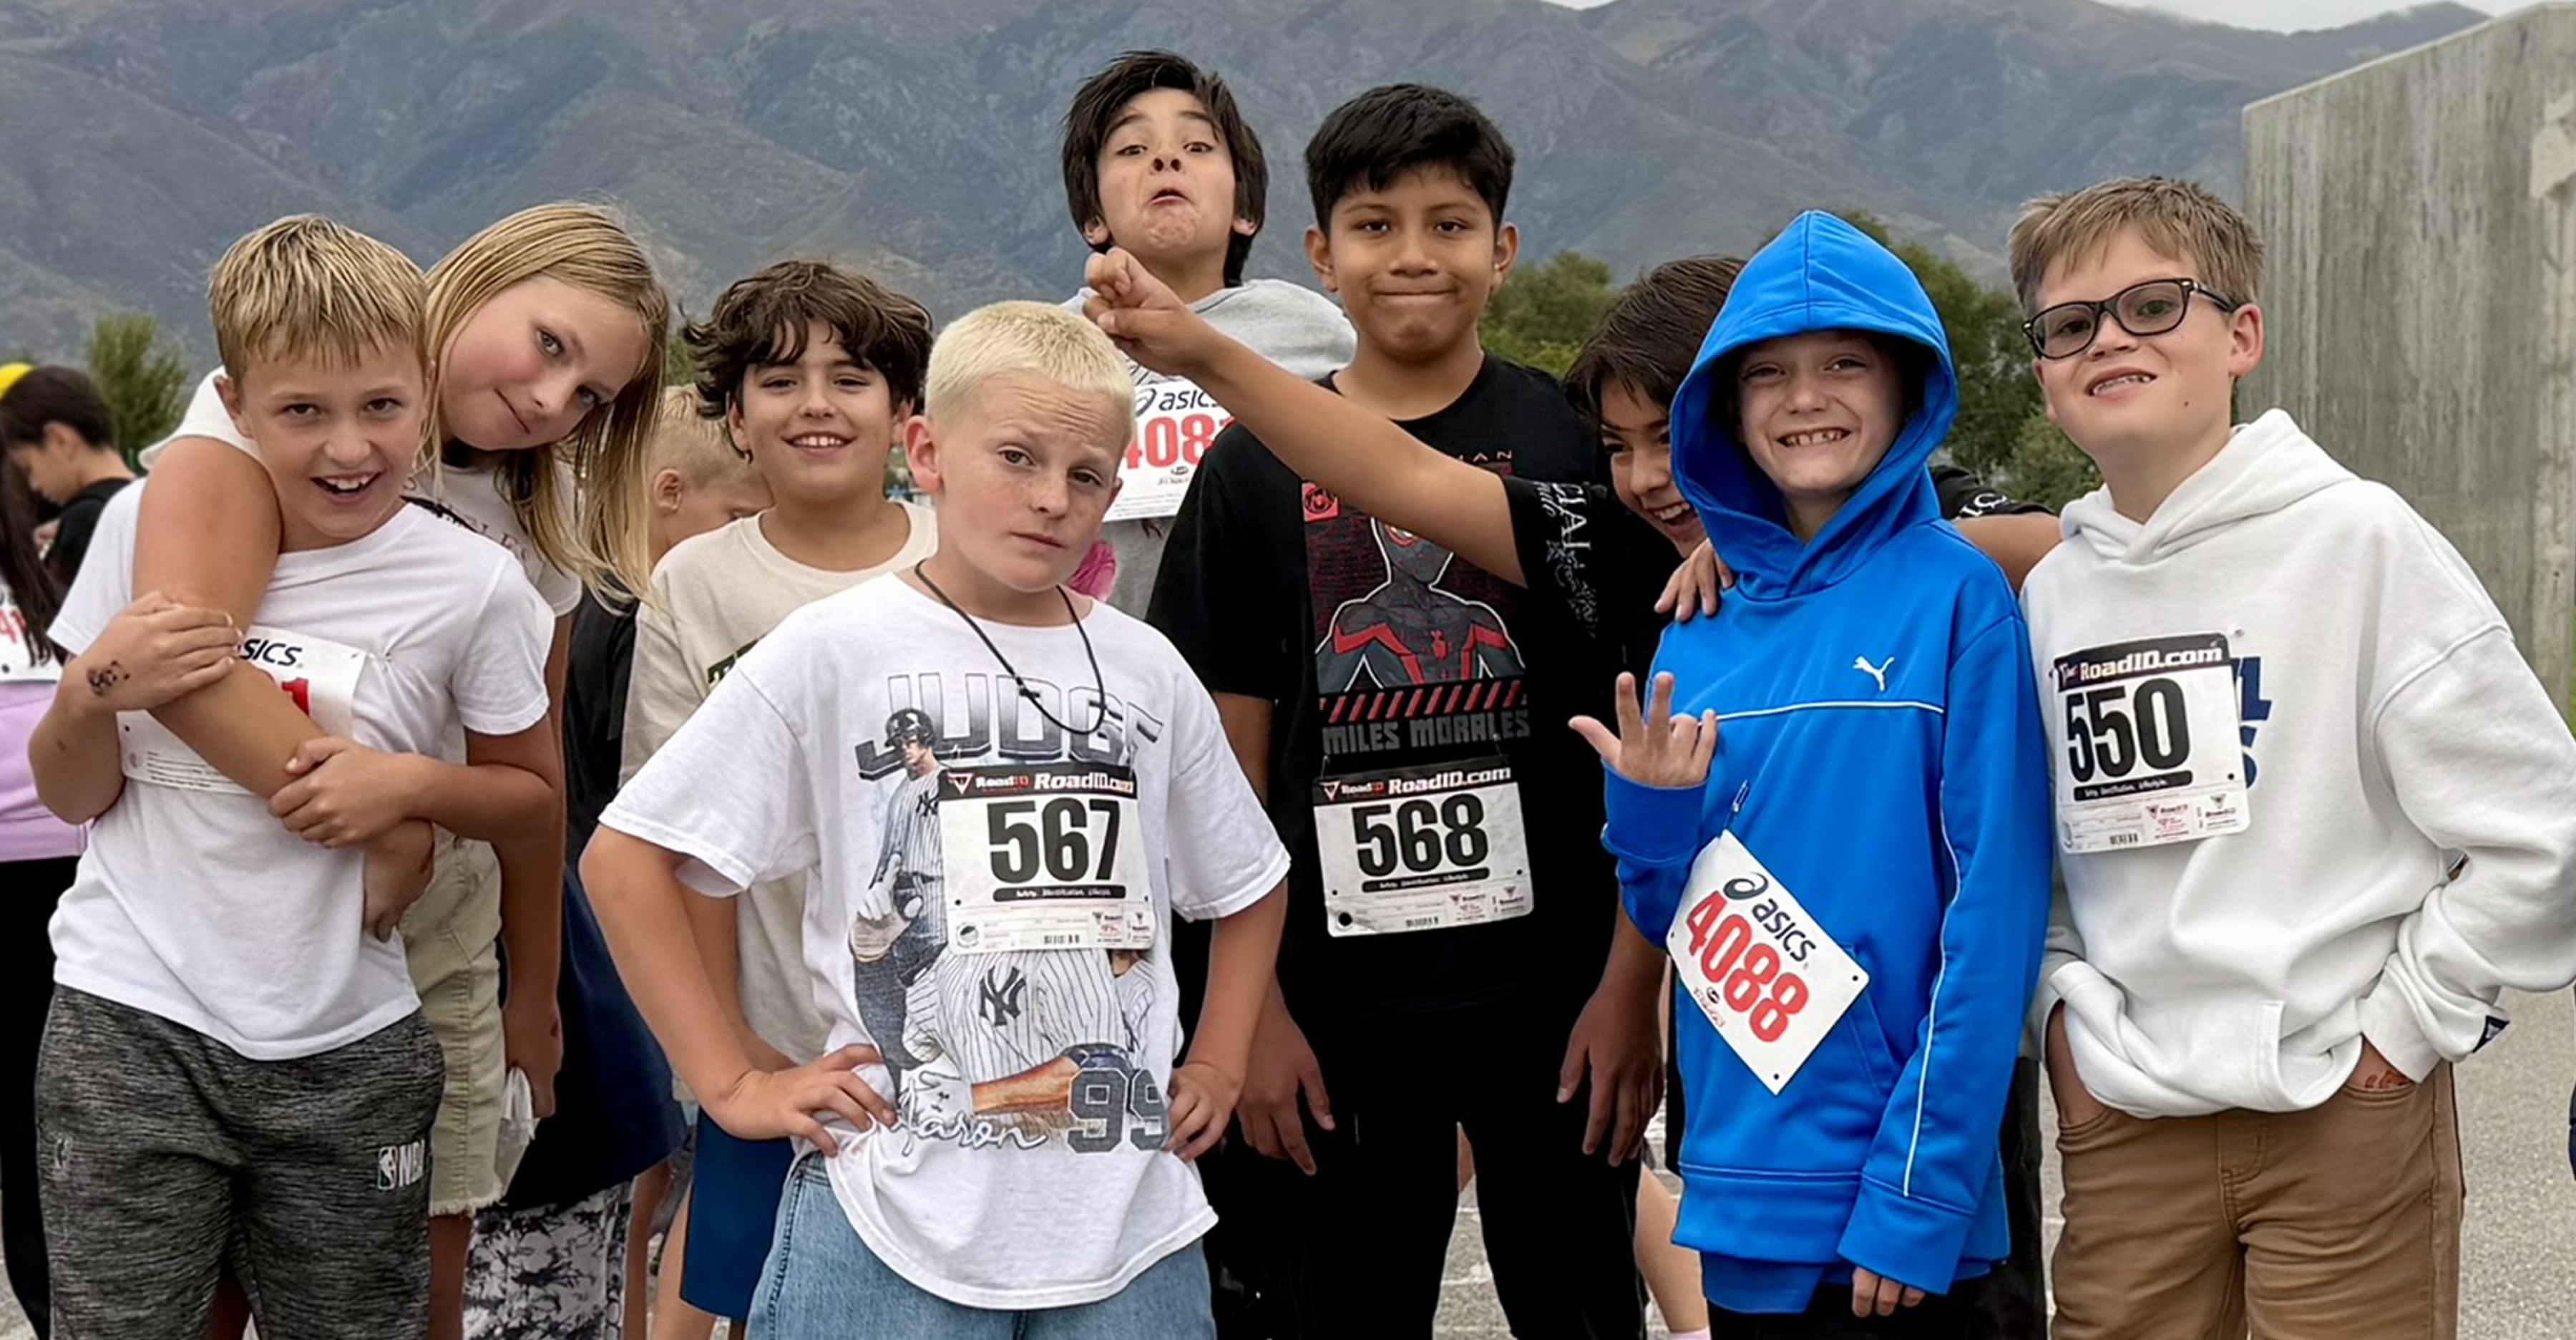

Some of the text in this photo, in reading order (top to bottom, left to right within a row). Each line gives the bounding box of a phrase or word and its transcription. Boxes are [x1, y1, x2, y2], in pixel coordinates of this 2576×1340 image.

[1126, 413, 1236, 470] 08
[2079, 647, 2223, 681] RoadID.com
[1322, 710, 1531, 754] MILES MORALES
[2066, 677, 2190, 782] 550
[1388, 767, 1512, 795] RoadID.com
[987, 797, 1121, 884] 567
[1352, 793, 1489, 877] 568
[1686, 890, 1810, 1043] 4088
[1067, 1067, 1167, 1154] 99
